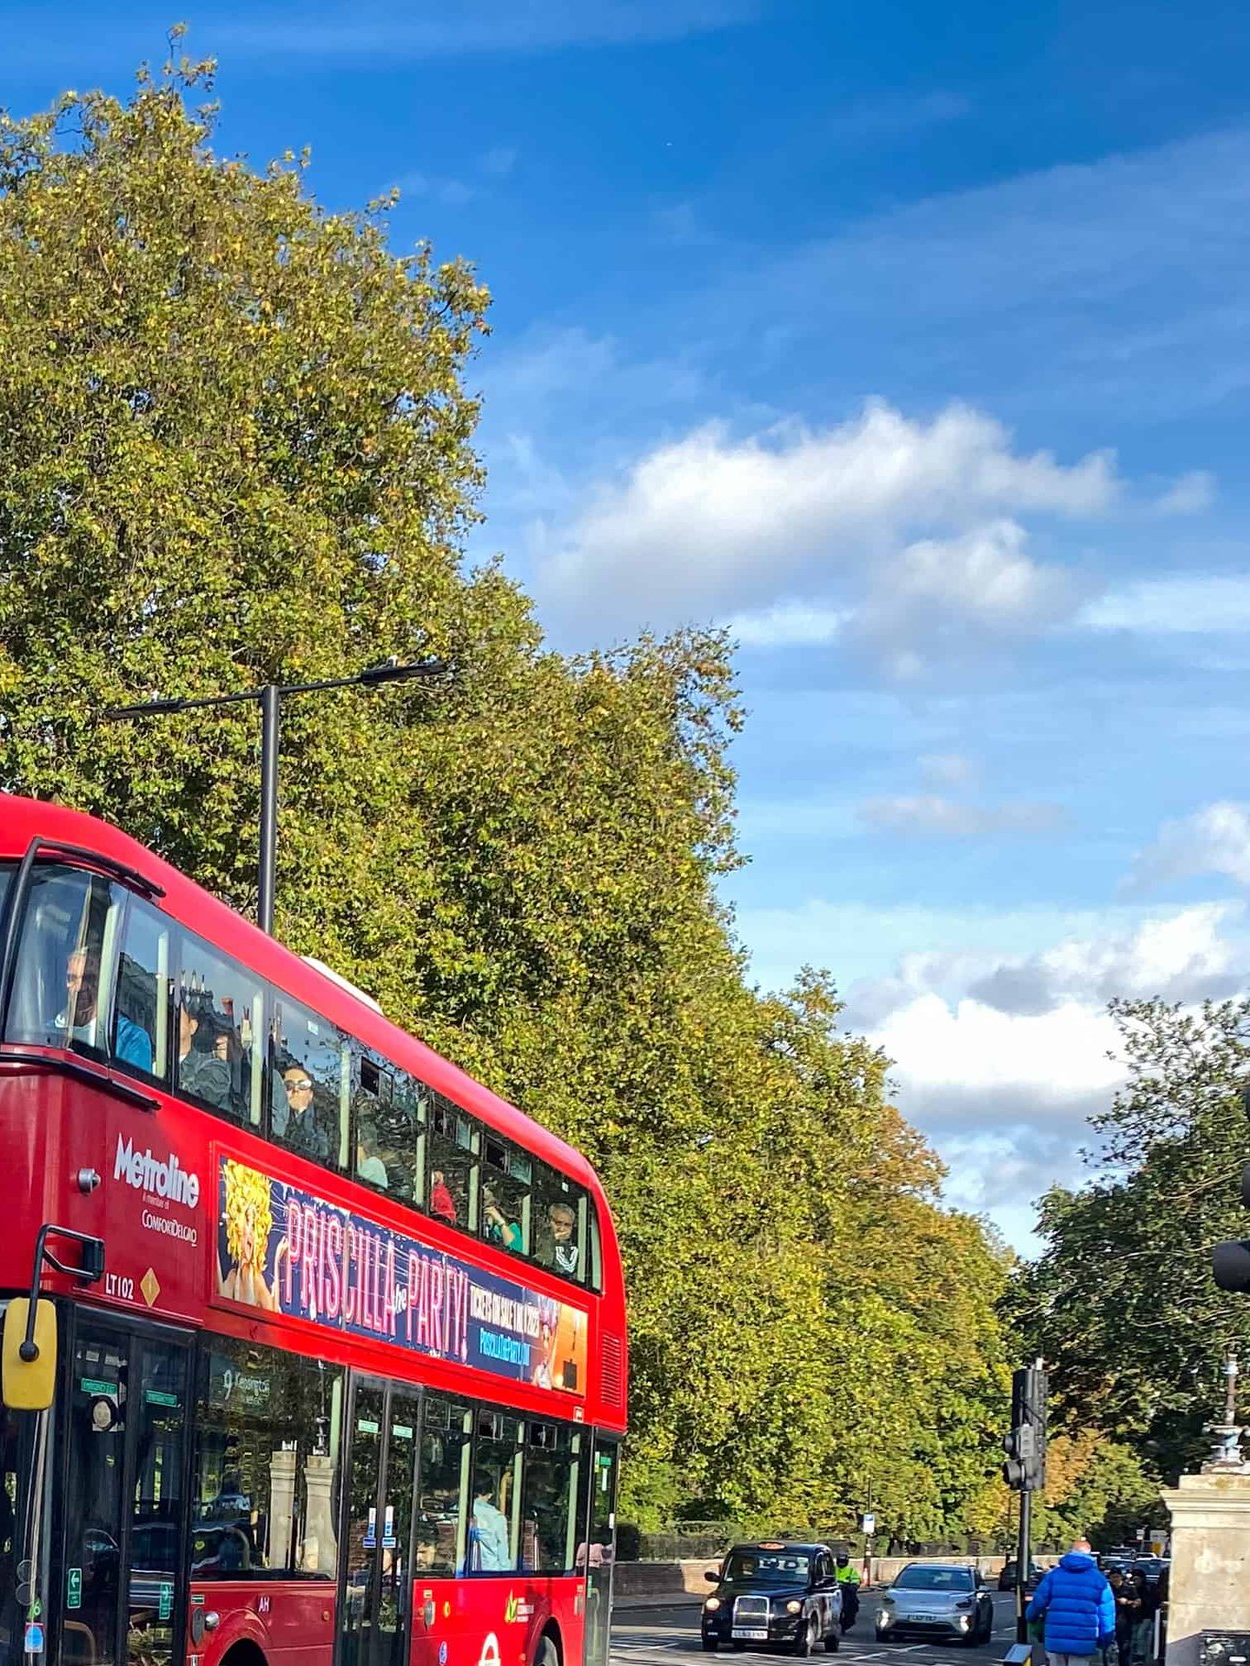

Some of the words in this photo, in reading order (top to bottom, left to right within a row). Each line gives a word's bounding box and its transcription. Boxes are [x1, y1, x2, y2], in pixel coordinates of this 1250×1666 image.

[114, 1132, 200, 1208] Metroline
[106, 1273, 134, 1299] LT102
[285, 1197, 396, 1336] PRISCILLA
[407, 1248, 469, 1363] PARTY!
